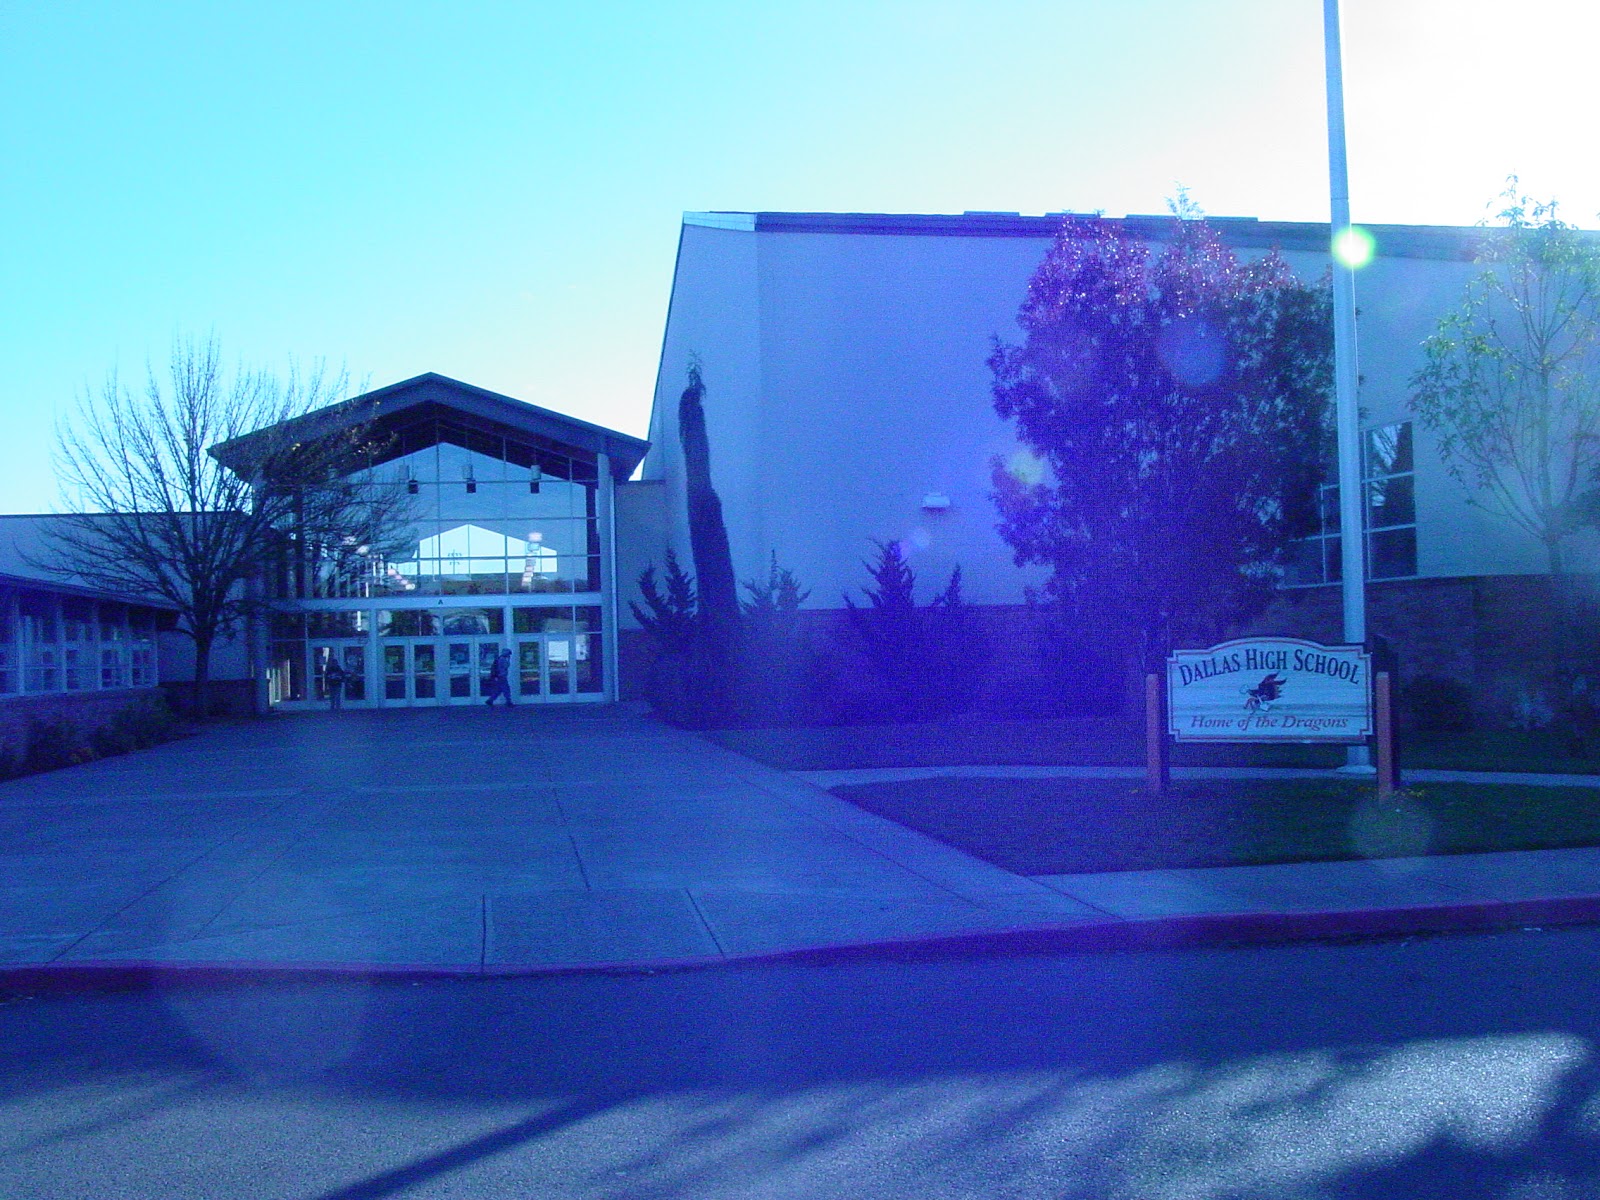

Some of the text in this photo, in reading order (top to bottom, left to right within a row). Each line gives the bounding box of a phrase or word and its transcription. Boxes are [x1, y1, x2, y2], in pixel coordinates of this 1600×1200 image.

[1179, 649, 1360, 686] DALLAS HIGH SCHOOL
[1191, 715, 1349, 731] Home of the Dragons
